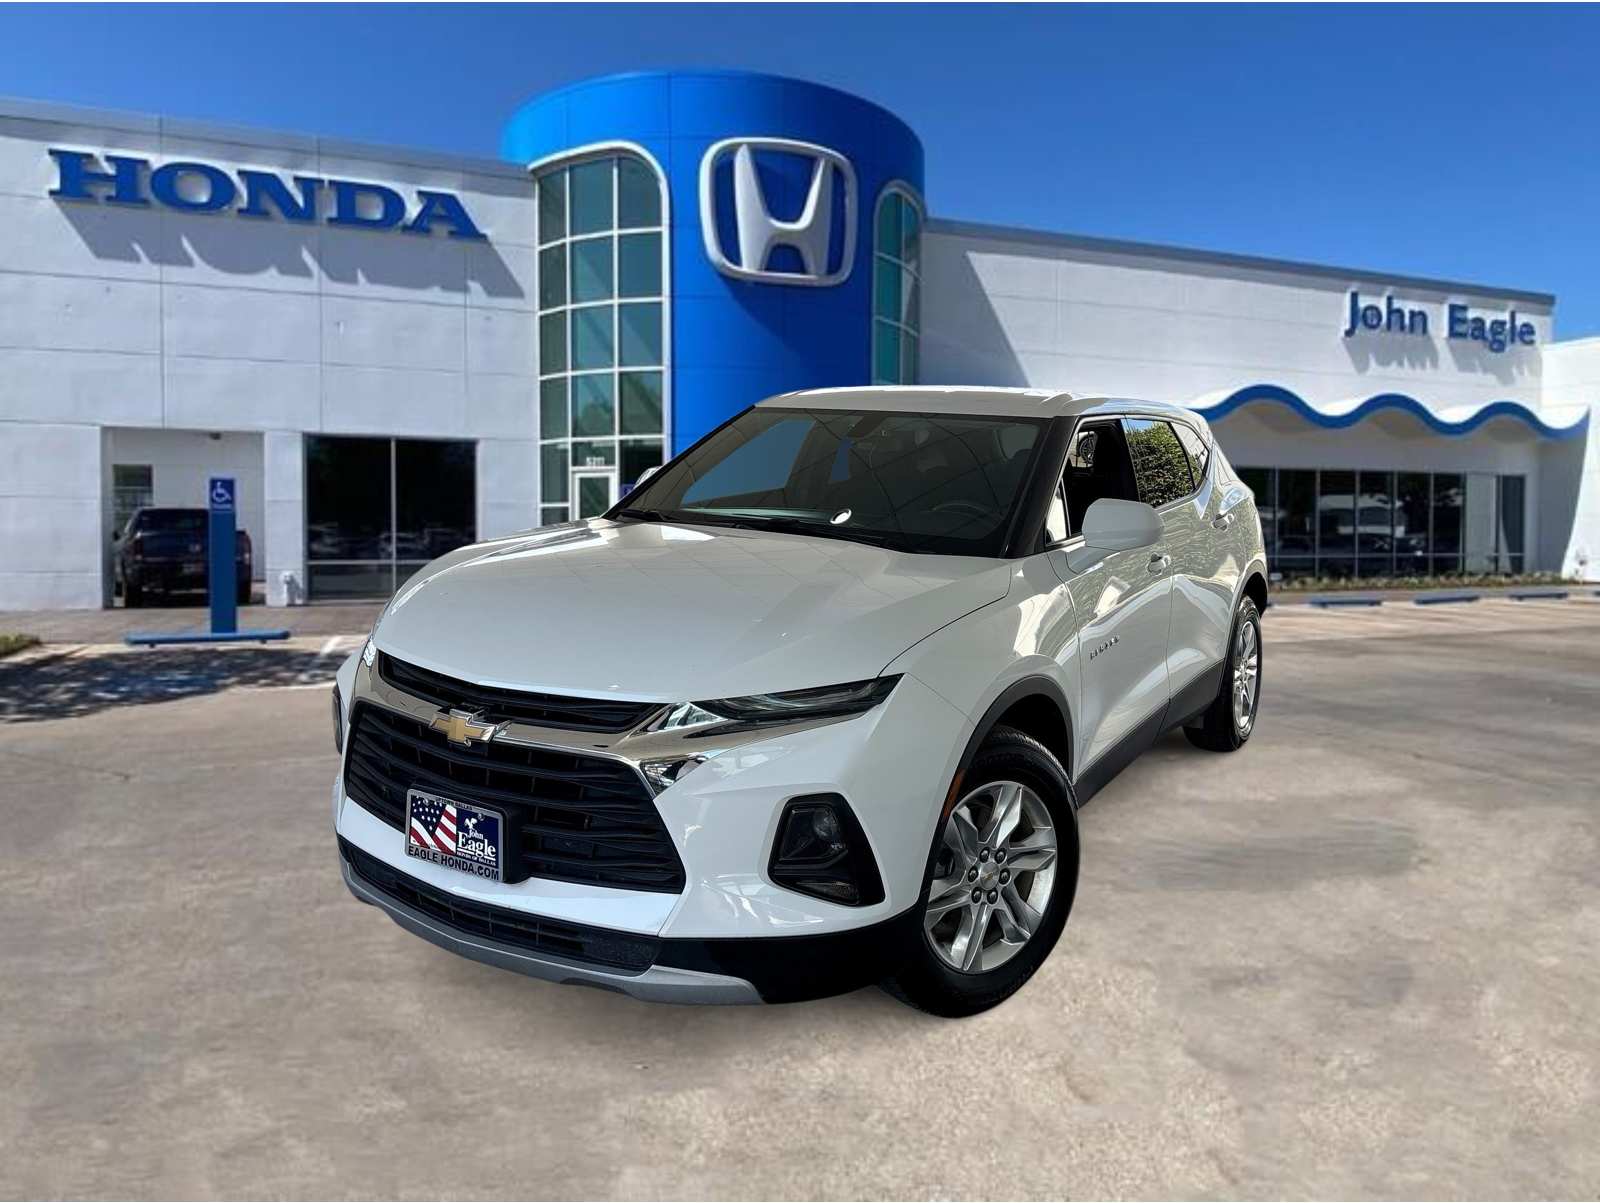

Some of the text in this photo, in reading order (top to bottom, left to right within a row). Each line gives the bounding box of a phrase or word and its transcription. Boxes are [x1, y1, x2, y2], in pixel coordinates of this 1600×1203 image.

[48, 148, 487, 241] HONDA
[1344, 290, 1536, 353] John Eagle
[457, 831, 497, 858] Eagle
[466, 829, 484, 840] John
[408, 846, 499, 880] EAGLE HONDA.COM
